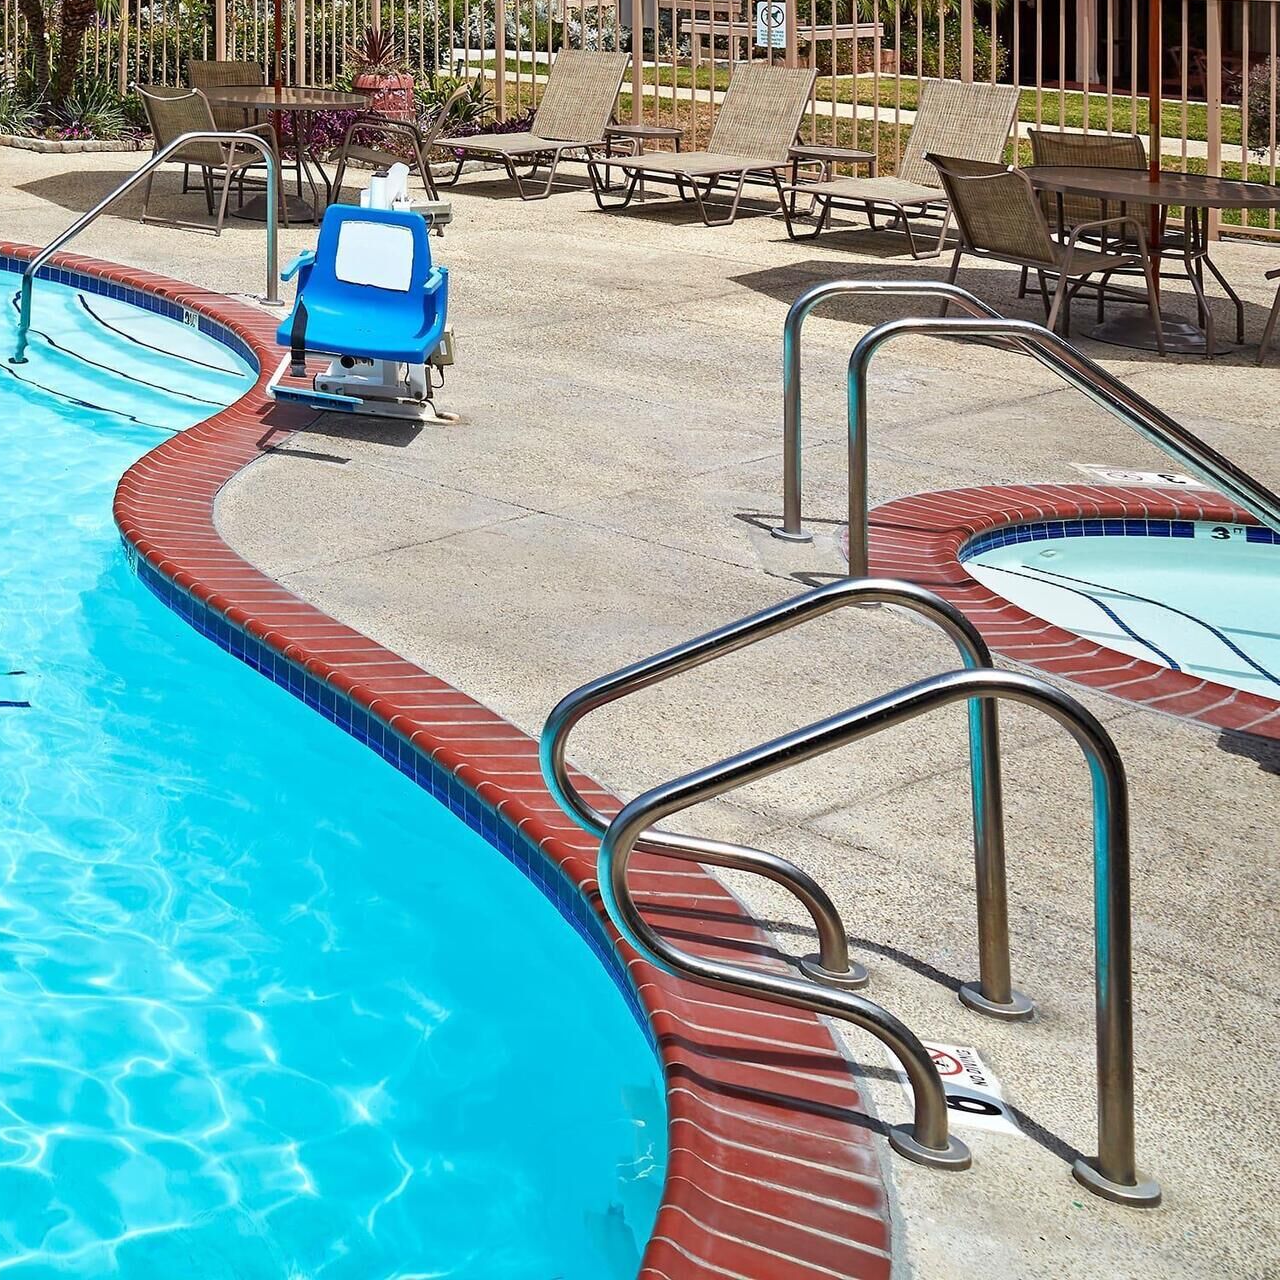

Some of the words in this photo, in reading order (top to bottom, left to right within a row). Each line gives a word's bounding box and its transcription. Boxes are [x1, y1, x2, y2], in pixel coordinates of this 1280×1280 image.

[1210, 526, 1230, 540] 3
[956, 1049, 981, 1074] DIVING
[969, 1075, 988, 1086] NO
